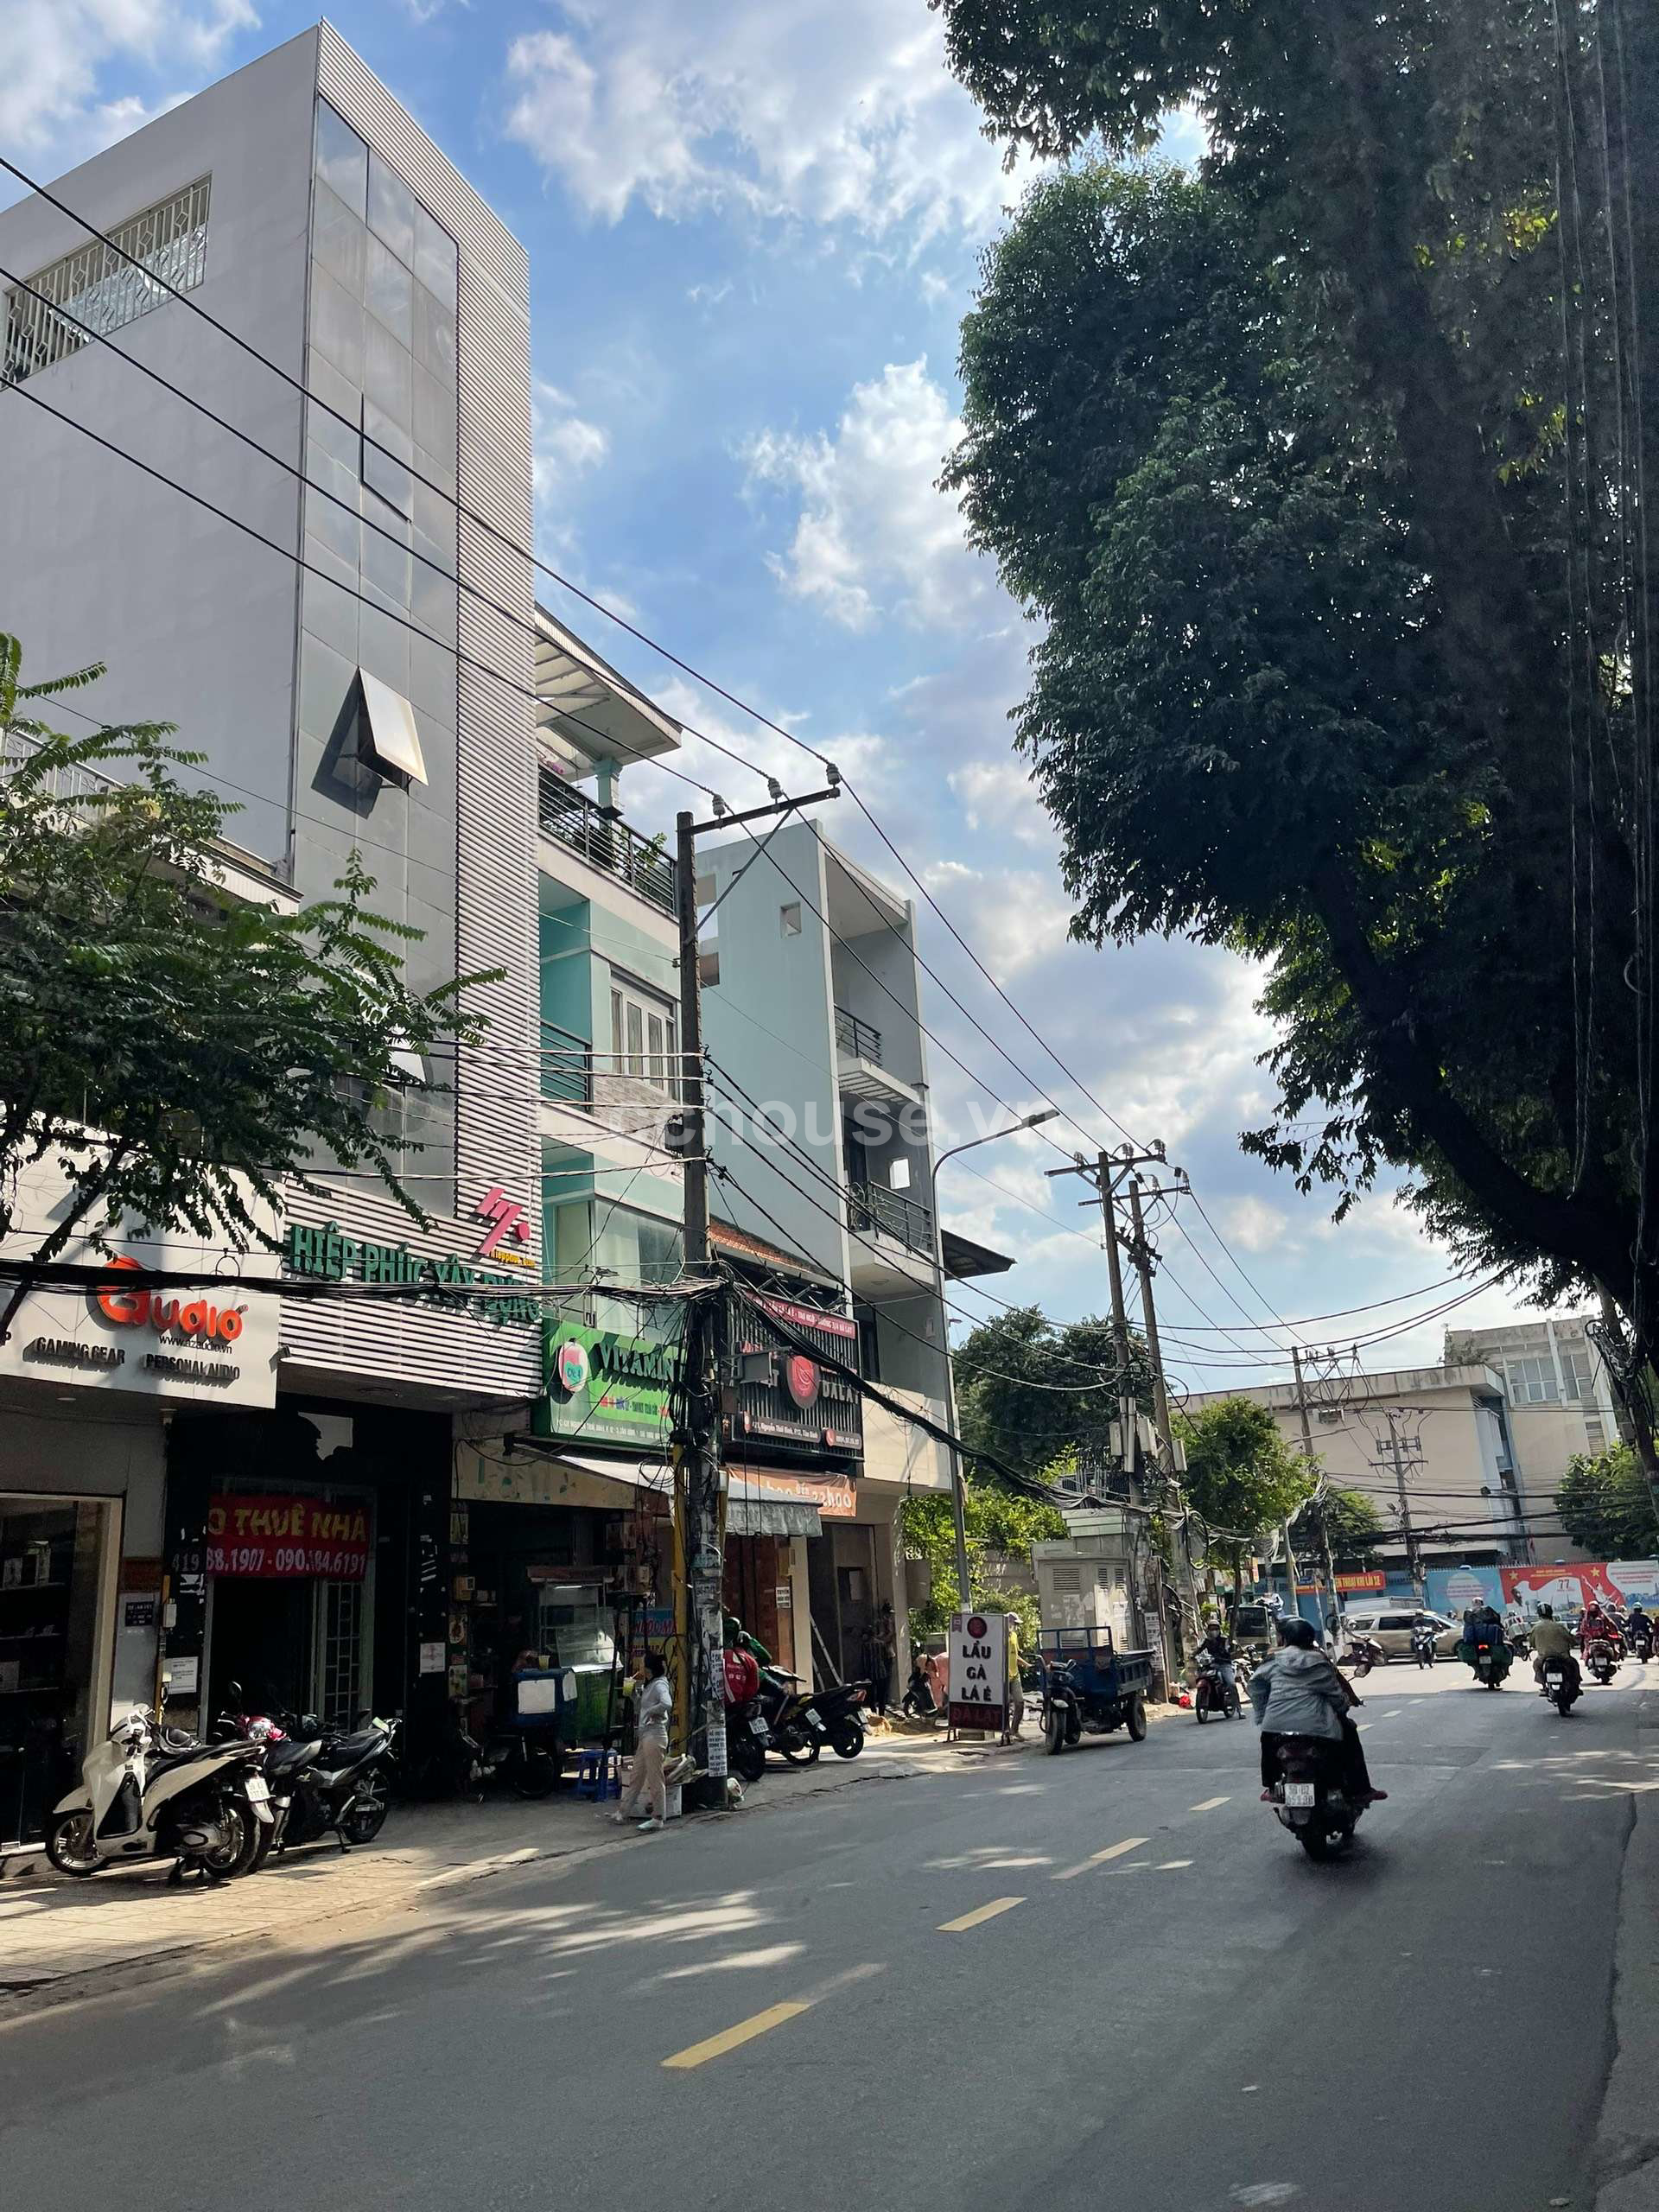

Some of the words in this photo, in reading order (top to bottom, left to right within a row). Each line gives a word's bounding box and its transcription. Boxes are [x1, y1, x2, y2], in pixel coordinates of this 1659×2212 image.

[36, 1337, 90, 1358] GAMING
[91, 1345, 125, 1364] GEAR
[159, 1335, 232, 1355] www.azaudio.vn
[146, 1353, 205, 1376] PERSONAL
[207, 1362, 241, 1381] AUDIO
[599, 1342, 675, 1382] VITAMIN
[235, 1503, 305, 1536] THUÊ
[962, 1640, 991, 1659] LẨU
[966, 1664, 987, 1680] GÀ
[961, 1685, 980, 1700] LÁ
[983, 1685, 992, 1701] É
